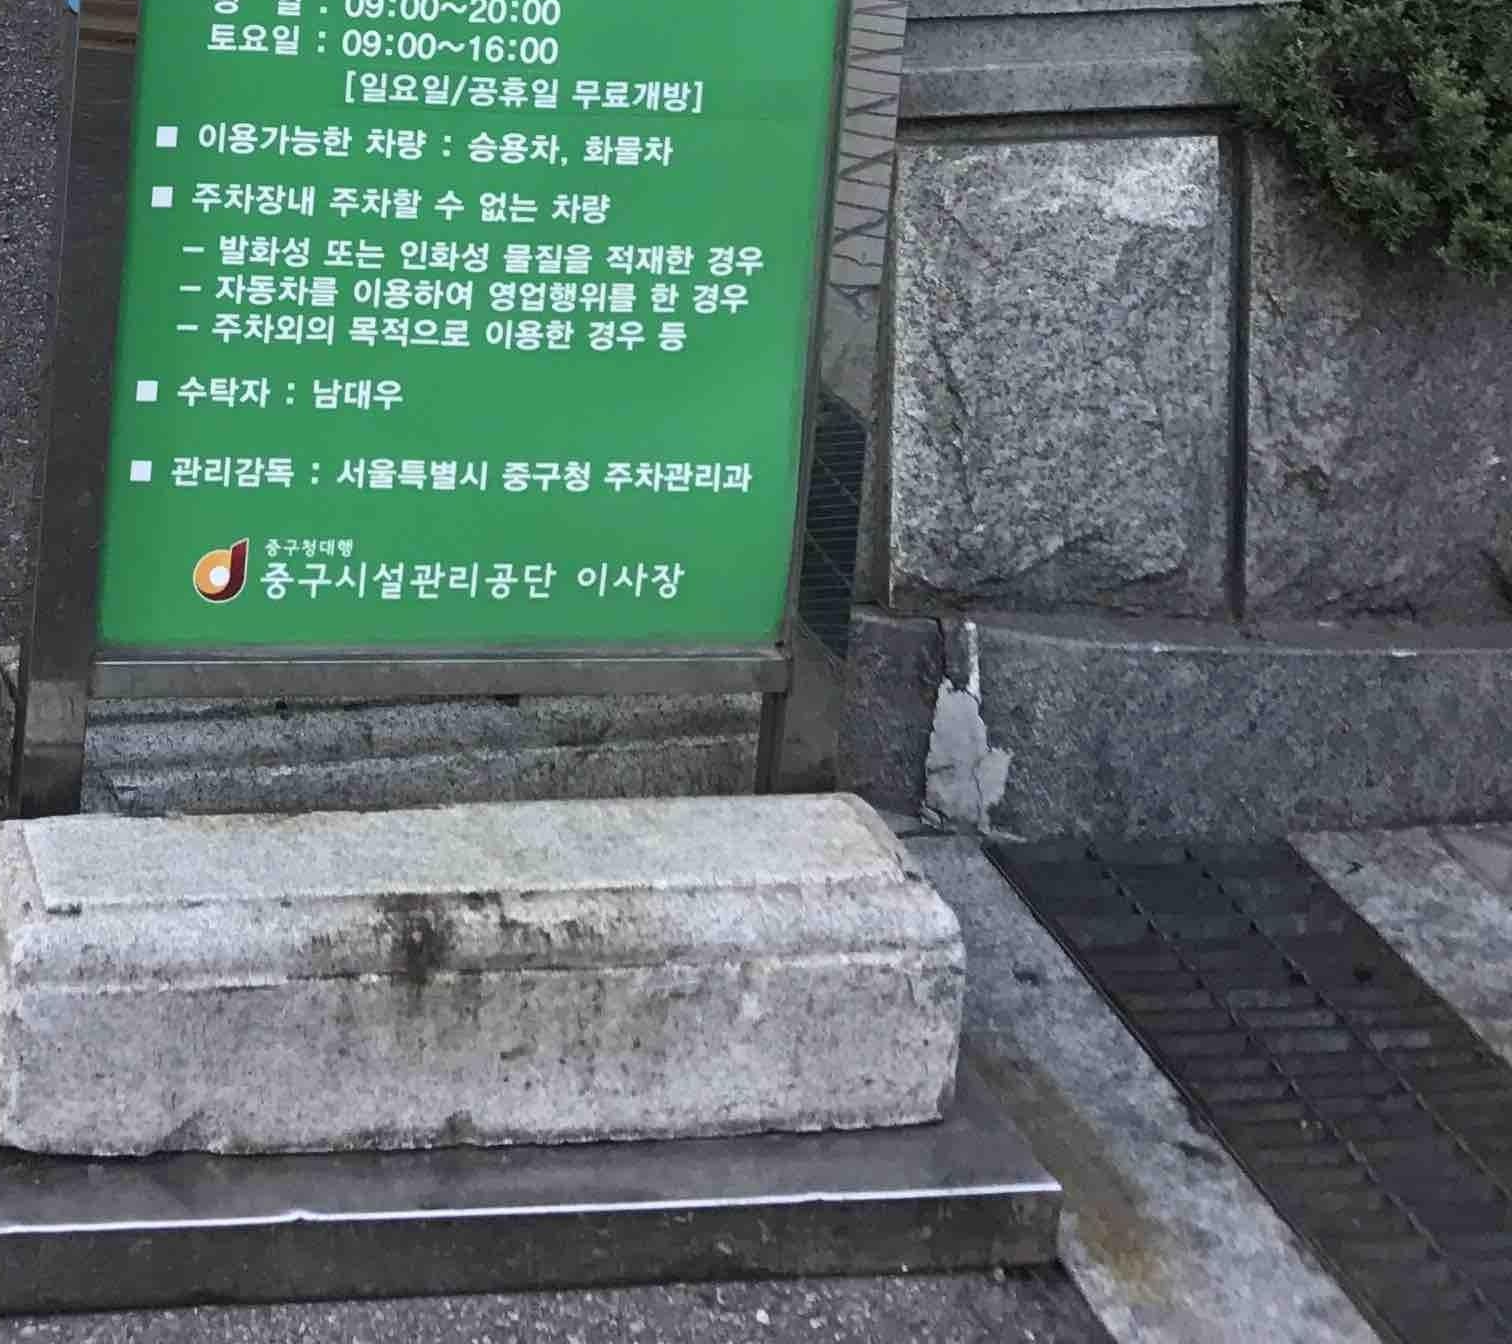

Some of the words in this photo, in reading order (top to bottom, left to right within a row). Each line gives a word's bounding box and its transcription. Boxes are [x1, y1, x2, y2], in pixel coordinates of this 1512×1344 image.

[208, 24, 299, 55] 토요일
[199, 123, 352, 156] 이용가능한
[367, 129, 426, 159] 차량
[468, 132, 567, 166] 승용차,
[584, 136, 673, 166] 화물차
[192, 184, 314, 216] 주차장내
[330, 188, 421, 218] 주차할
[435, 191, 464, 220] 수
[480, 193, 537, 222] 없는
[552, 195, 610, 224] 차량
[220, 235, 309, 267] 발화성
[324, 240, 384, 268] 또는
[400, 241, 488, 272] 인화성
[504, 245, 592, 274] 물질을
[607, 246, 694, 274] 적재한
[708, 247, 763, 276] 경우
[216, 275, 338, 306] 자동차를
[354, 278, 472, 310] 이용하여
[490, 282, 636, 312] 영업행위를
[651, 284, 679, 312] 한
[694, 284, 748, 313] 경우
[213, 314, 334, 345] 주차외의
[349, 317, 469, 347] 목적으로
[486, 320, 574, 350] 이용한
[589, 321, 644, 350] 경우
[659, 322, 686, 351] 등
[178, 377, 270, 407] 수탁자
[314, 380, 402, 410] 남대우
[172, 457, 293, 487] 관리감독
[337, 459, 487, 490] 서울특별시
[503, 462, 590, 491] 중구청
[605, 463, 752, 492] 주차관리과
[261, 563, 556, 599] 중구시설관리공단
[578, 563, 684, 598] 이사장
